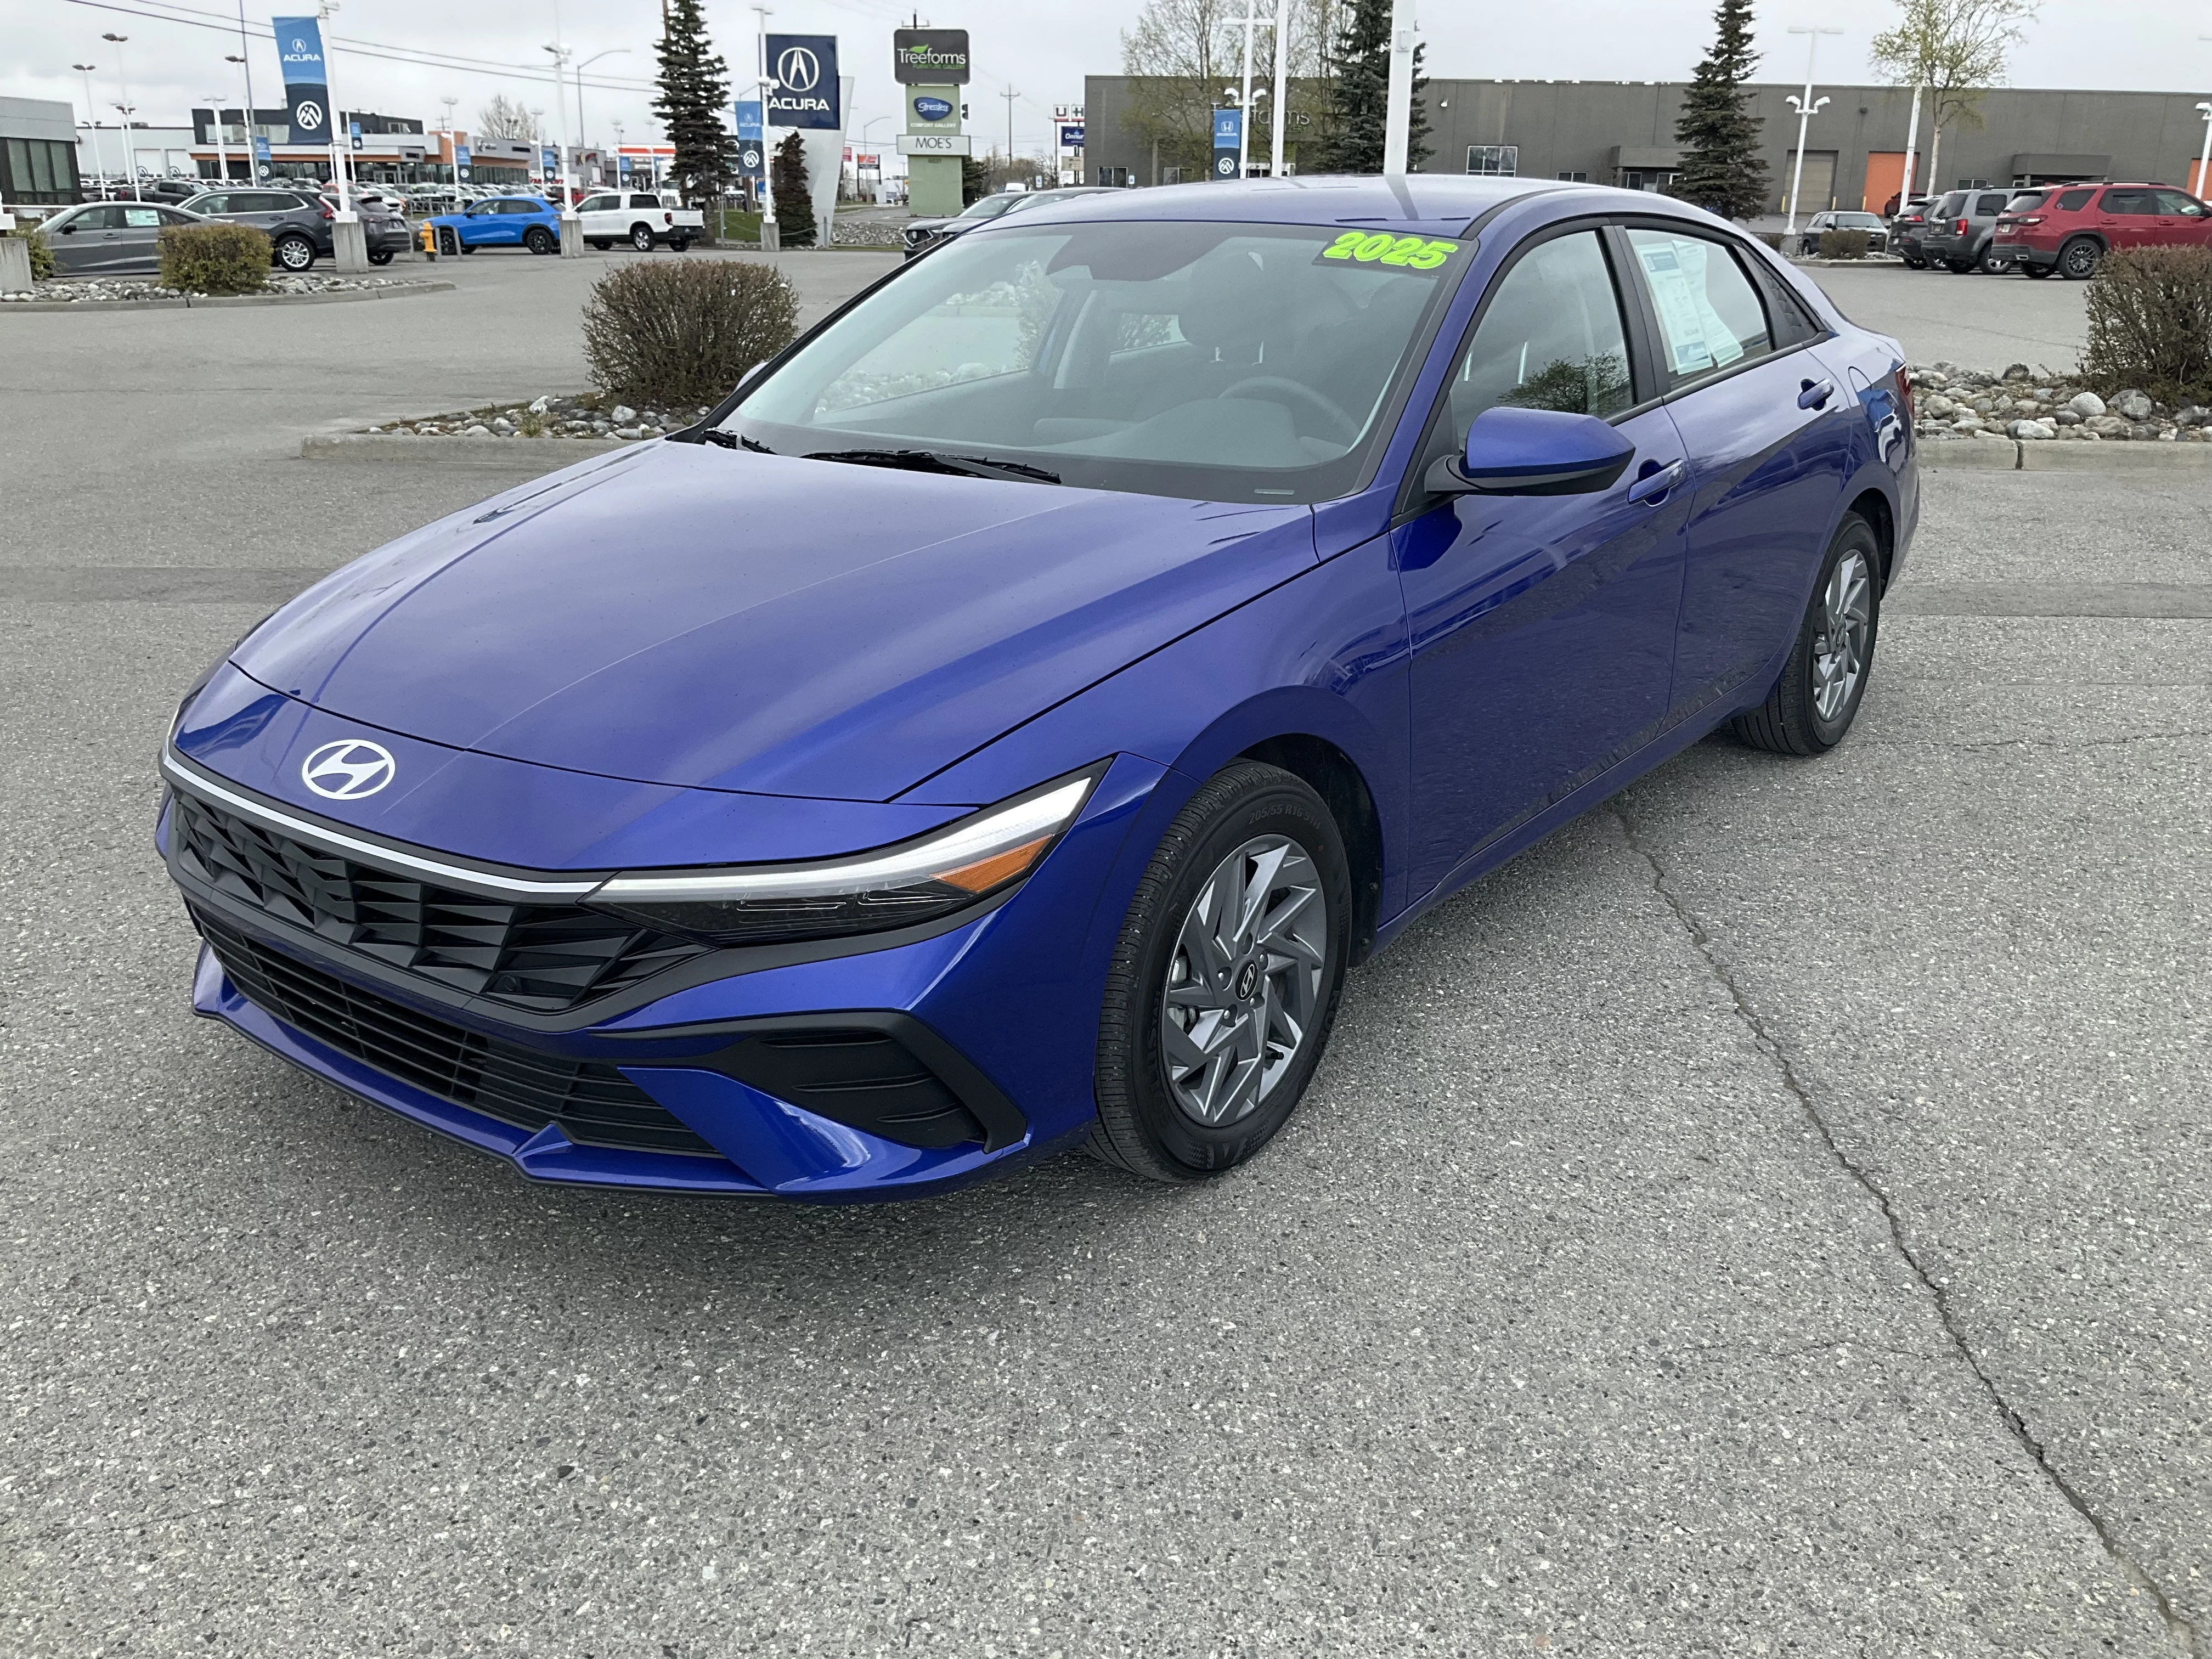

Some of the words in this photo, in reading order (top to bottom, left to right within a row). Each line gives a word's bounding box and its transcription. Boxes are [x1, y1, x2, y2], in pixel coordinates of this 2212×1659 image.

[897, 48, 966, 64] Treeforms
[768, 97, 830, 111] ACURA
[916, 137, 952, 149] MOE'S
[1323, 232, 1458, 269] 2025
[1249, 804, 1283, 825] 205/55
[1284, 804, 1304, 817] R16
